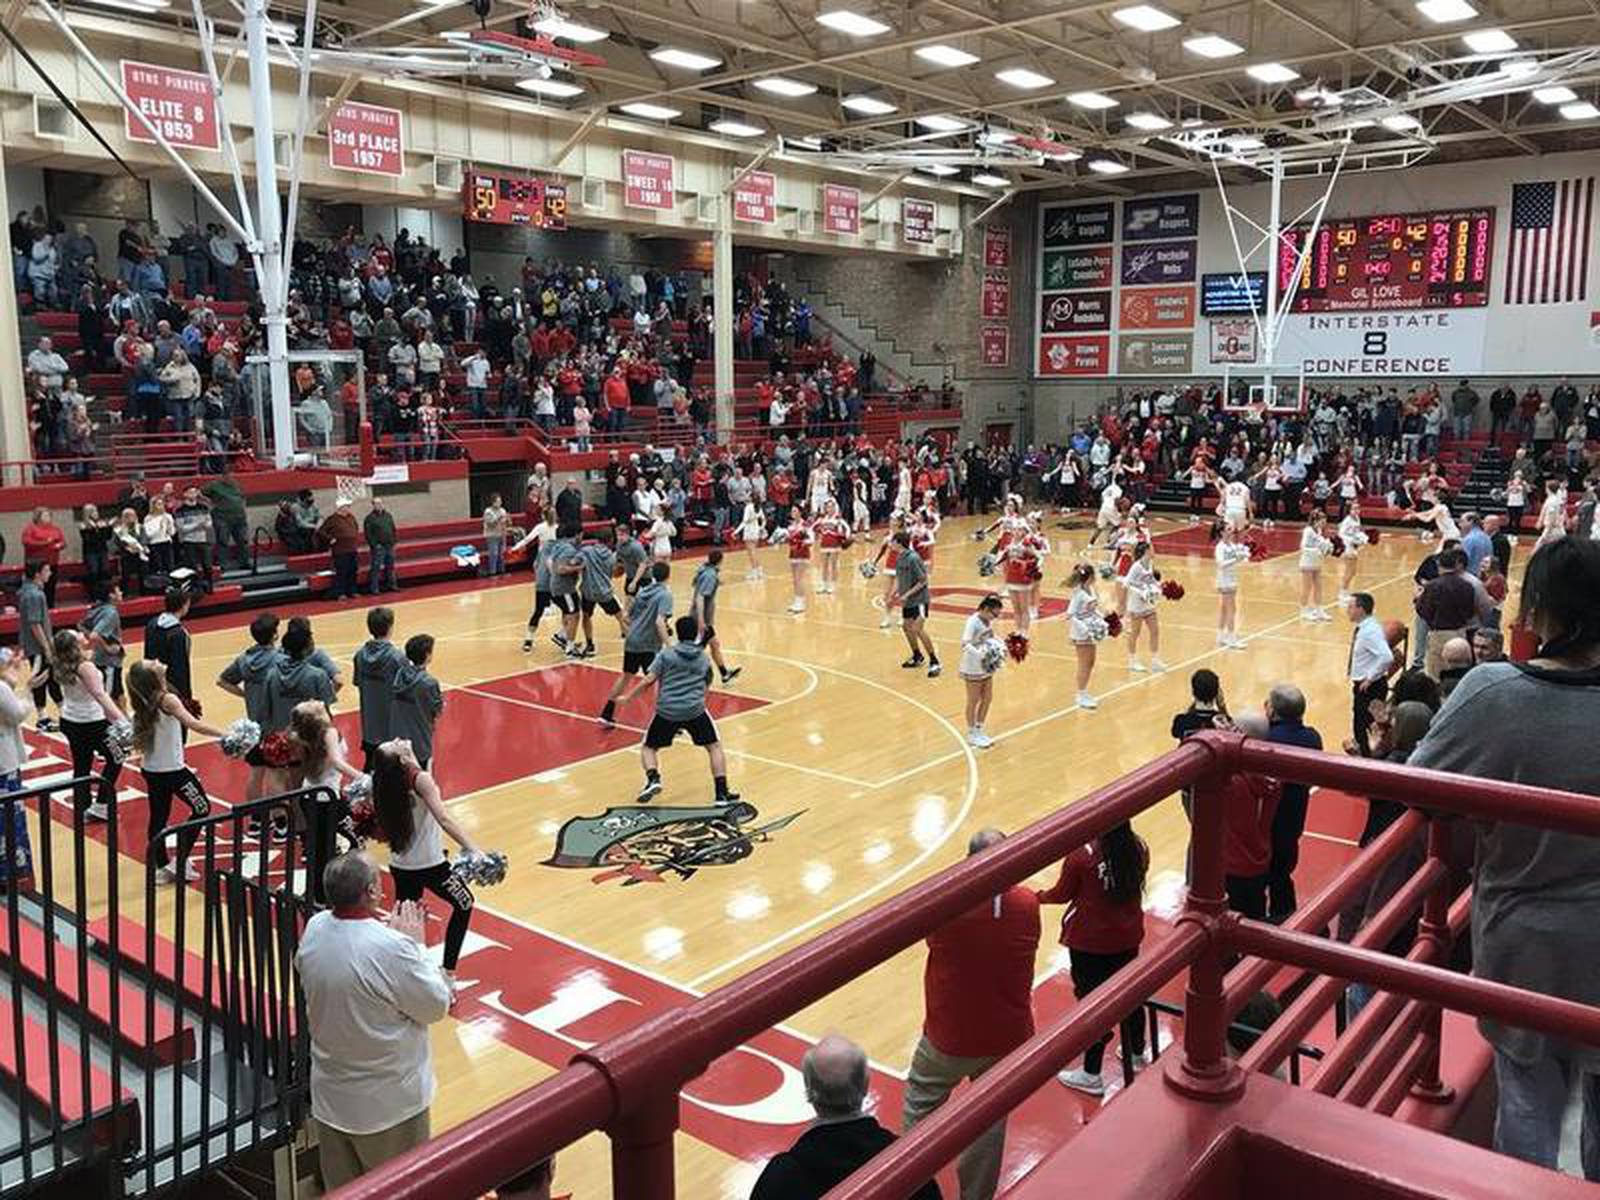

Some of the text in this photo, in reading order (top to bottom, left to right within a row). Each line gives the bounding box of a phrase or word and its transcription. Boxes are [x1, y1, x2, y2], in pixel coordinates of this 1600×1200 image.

[139, 97, 204, 124] ELITE 8
[333, 128, 400, 154] 3rd PLACE
[352, 148, 384, 168] 1957
[476, 188, 496, 210] 50
[547, 198, 565, 219] 42
[1337, 229, 1357, 246] 50
[1407, 223, 1427, 240] 42
[1392, 237, 1402, 250] 0
[1337, 263, 1347, 279] 0
[1411, 259, 1421, 273] 0
[1351, 285, 1402, 299] GIL LOVE
[1309, 313, 1450, 330] INTERSTATE
[1363, 331, 1387, 355] 8
[1303, 357, 1450, 374] CONFERENCE
